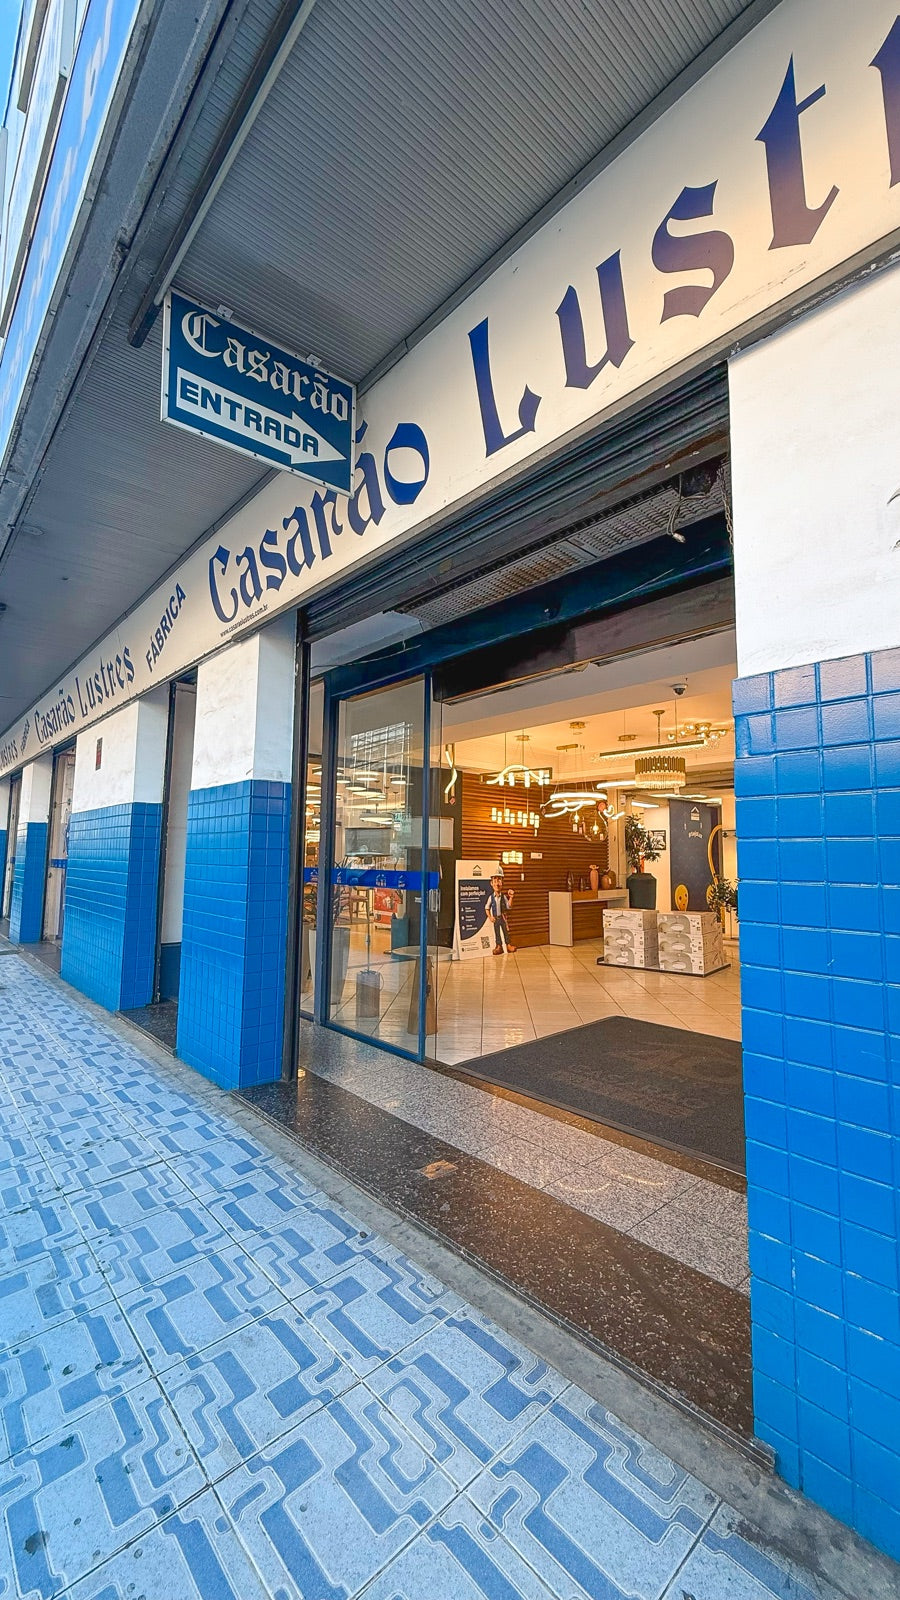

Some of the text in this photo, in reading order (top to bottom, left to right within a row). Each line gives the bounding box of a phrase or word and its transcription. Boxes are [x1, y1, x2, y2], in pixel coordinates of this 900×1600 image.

[181, 309, 349, 422] Casarão
[179, 380, 319, 457] ENTRADA
[145, 582, 187, 673] FÁBRICA
[34, 687, 76, 744] Casarão
[75, 646, 135, 718] Lustres
